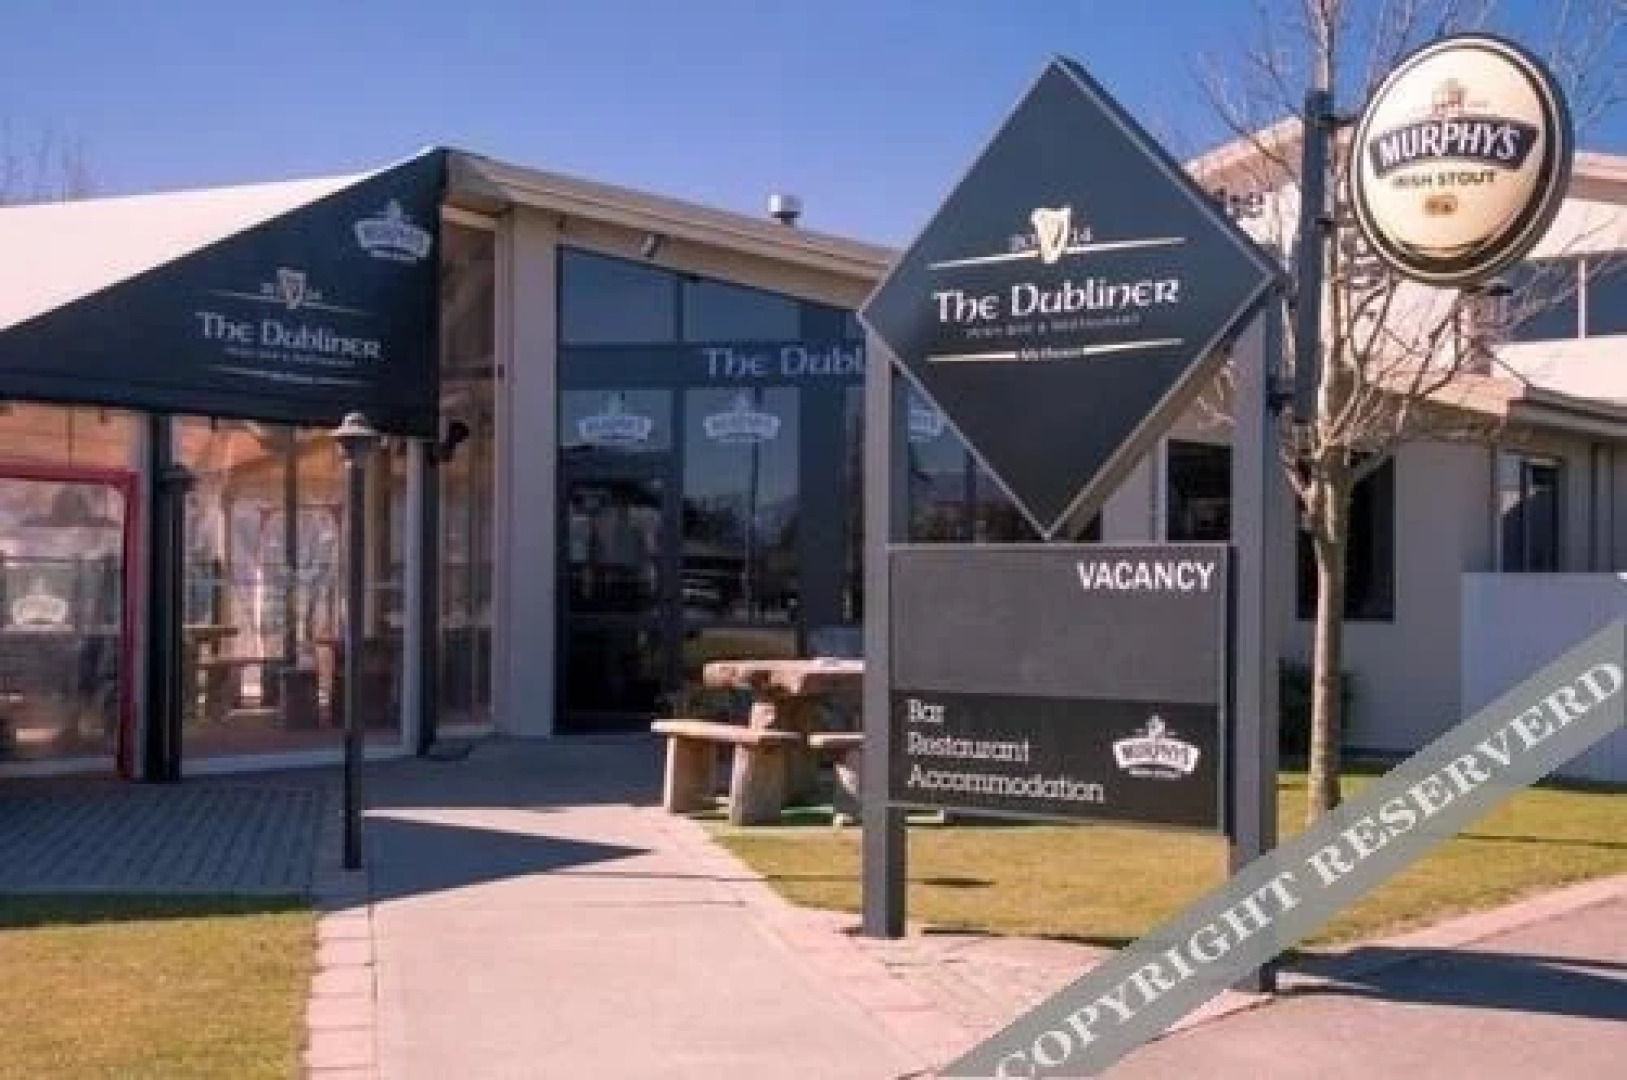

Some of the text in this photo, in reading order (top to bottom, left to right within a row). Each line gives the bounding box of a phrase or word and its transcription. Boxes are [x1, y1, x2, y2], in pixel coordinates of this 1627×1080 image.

[1437, 170, 1496, 187] STOUT
[931, 289, 1000, 323] The
[195, 311, 255, 343] The
[702, 344, 866, 378] The Dubl
[1076, 561, 1215, 591] VACANCY
[907, 699, 945, 723] Bar
[906, 731, 1030, 763] Restaurant
[906, 764, 1104, 804] Accommodation
